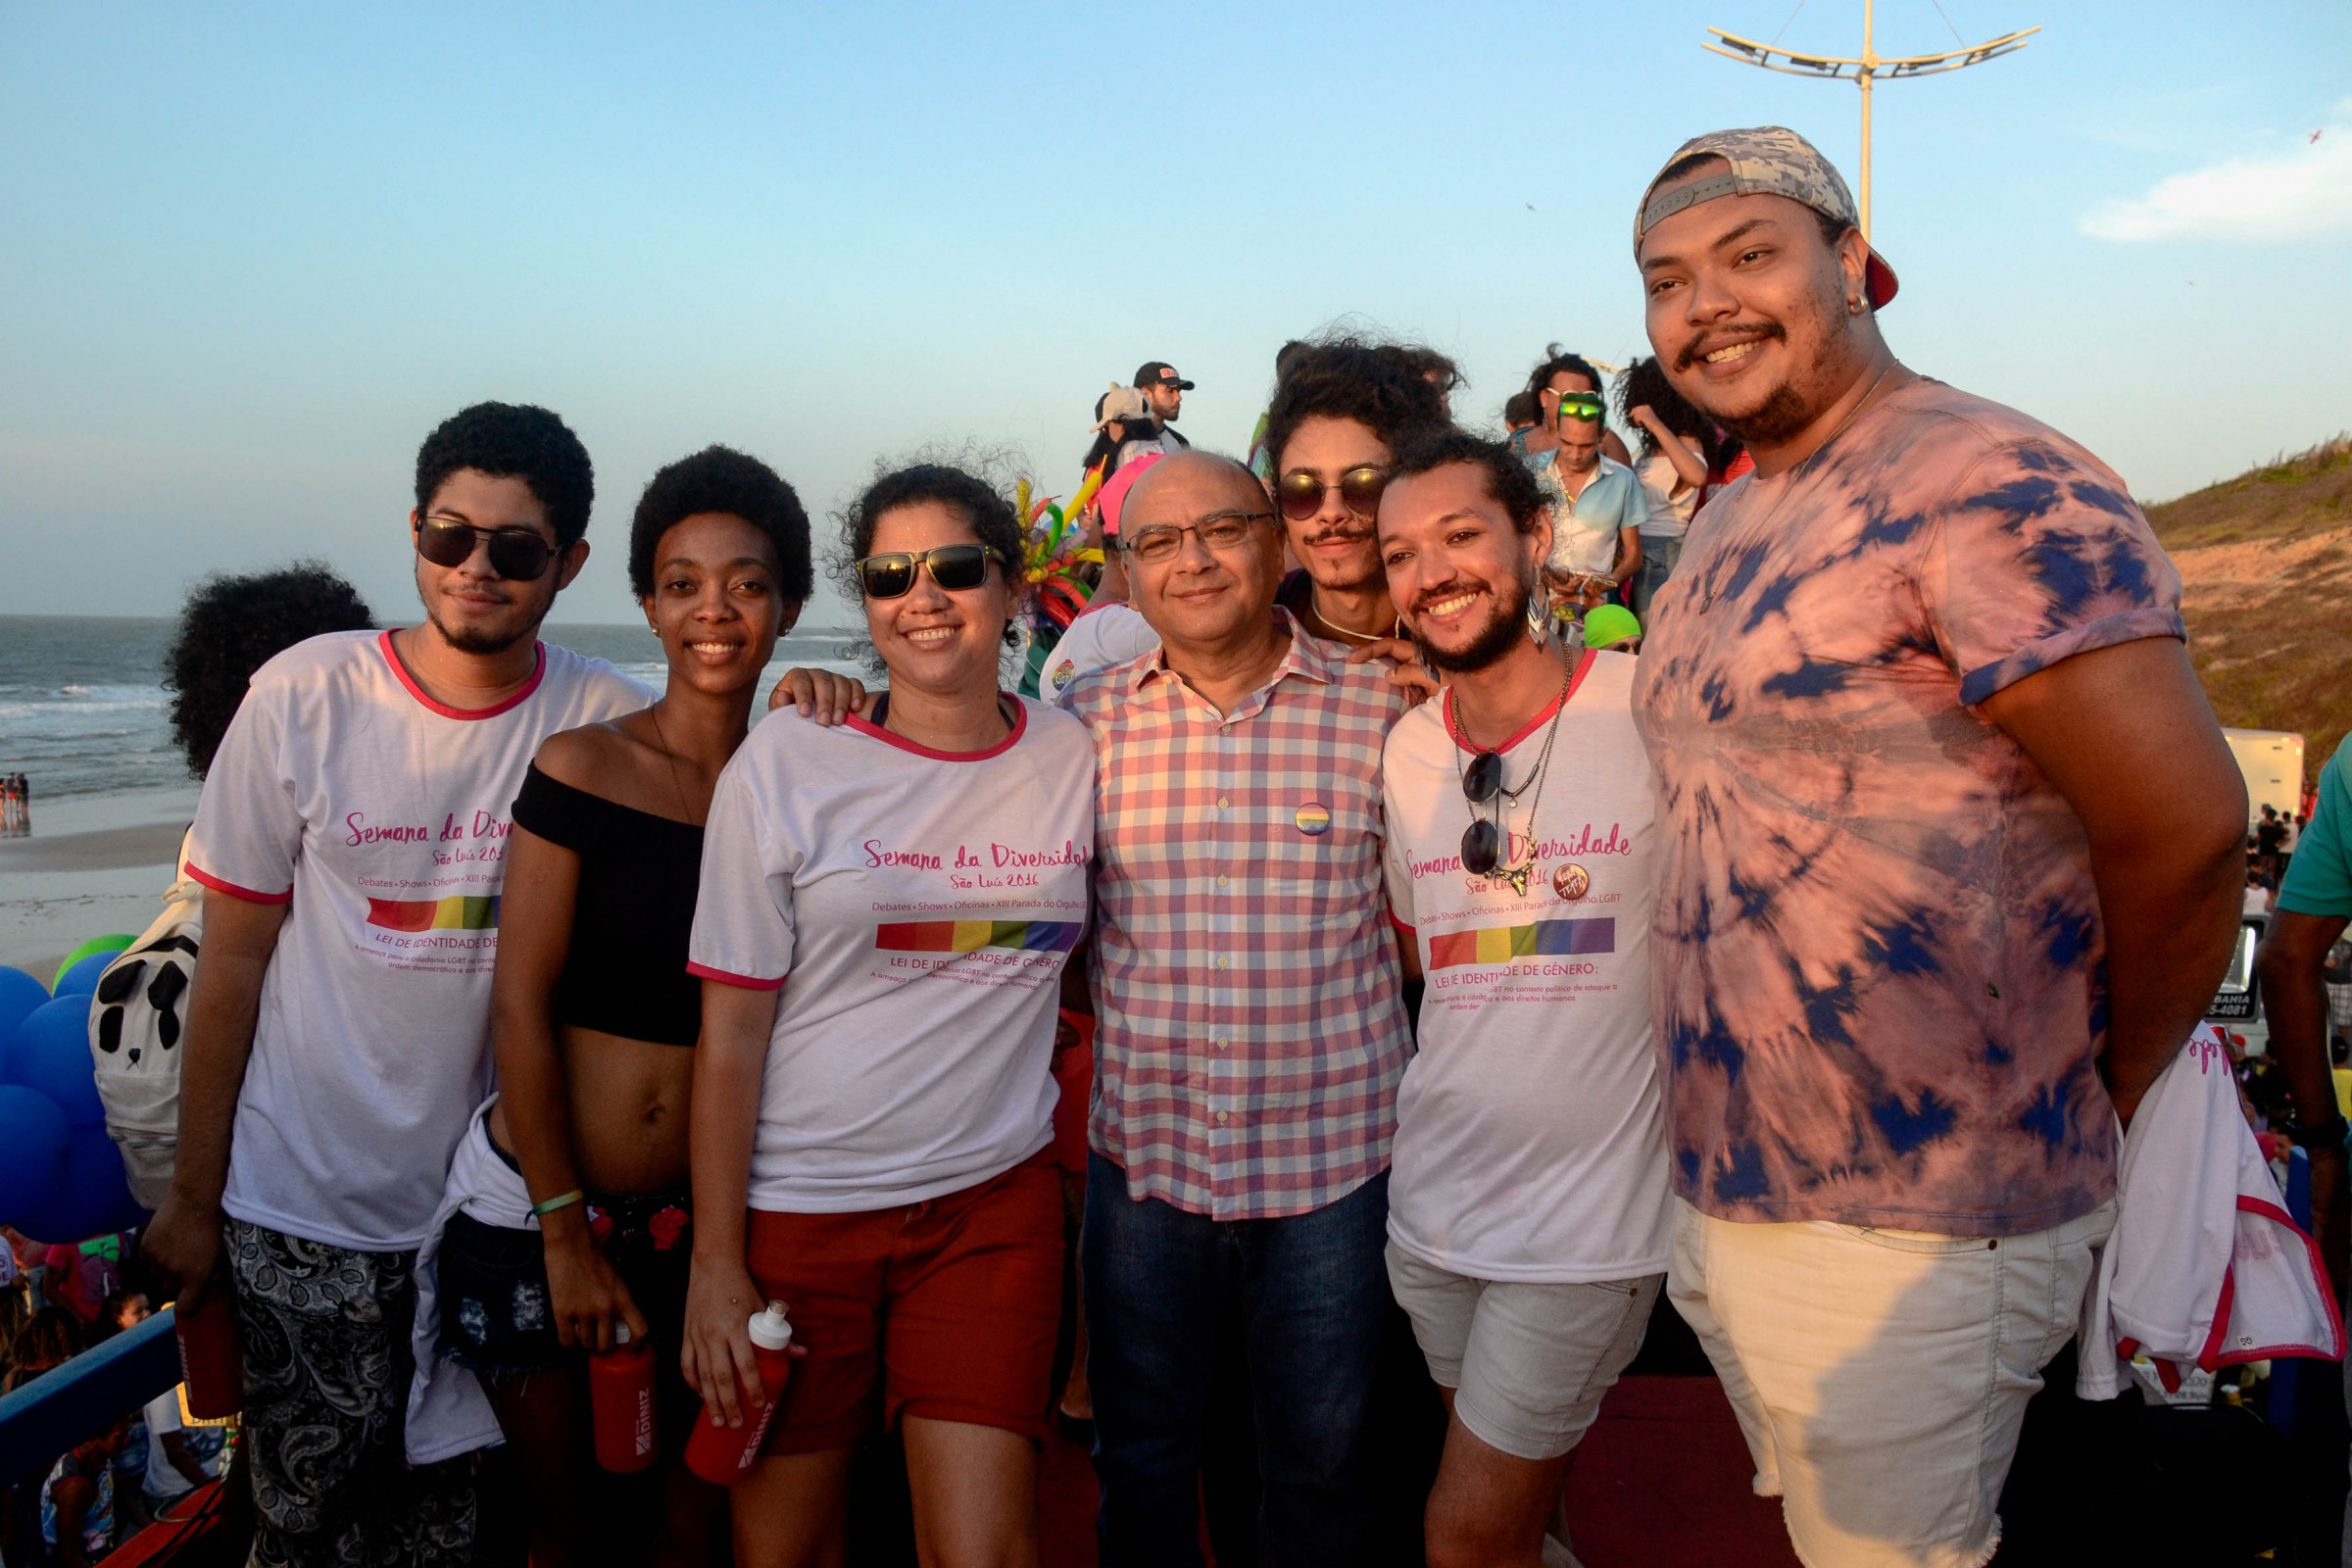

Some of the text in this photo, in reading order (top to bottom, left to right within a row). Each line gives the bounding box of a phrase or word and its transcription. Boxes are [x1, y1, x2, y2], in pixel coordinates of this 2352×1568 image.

[346, 811, 430, 847] Semana
[440, 812, 464, 843] da
[863, 839, 943, 870] Semana
[955, 845, 982, 869] da
[1507, 823, 1633, 864] Dversidade
[432, 850, 451, 866] São
[456, 847, 475, 863] Luís
[358, 877, 393, 888] Debates
[400, 879, 427, 888] Shows
[466, 874, 479, 883] XIII
[951, 872, 1039, 889] São Luís 2016
[1465, 877, 1488, 895] São
[1527, 868, 1548, 888] 016
[872, 902, 911, 911] Debates
[918, 902, 948, 910] Shows
[955, 901, 989, 909] Oficinas
[996, 900, 1009, 908] XIII
[1012, 899, 1041, 908] Parada
[1044, 900, 1054, 908] do
[1441, 911, 1467, 921] Shows
[1472, 906, 1504, 916] Oficinas
[1510, 904, 1522, 912] XIII
[1549, 897, 1560, 906] do
[1598, 893, 1622, 904] LGBT
[375, 933, 393, 944] LEI
[395, 938, 412, 948] DE
[413, 937, 480, 949] IDENTIDADE
[891, 957, 907, 967] LEI
[911, 959, 928, 969] DE
[1004, 956, 1019, 966] DE
[962, 968, 981, 977] LGBT
[1435, 976, 1449, 989] LEI
[1523, 965, 1539, 976] DE
[1543, 962, 1598, 976] GÊNERO:
[1585, 984, 1610, 993] ataque
[639, 1387, 651, 1435] DINIZ
[751, 1400, 775, 1447] DINIZ
